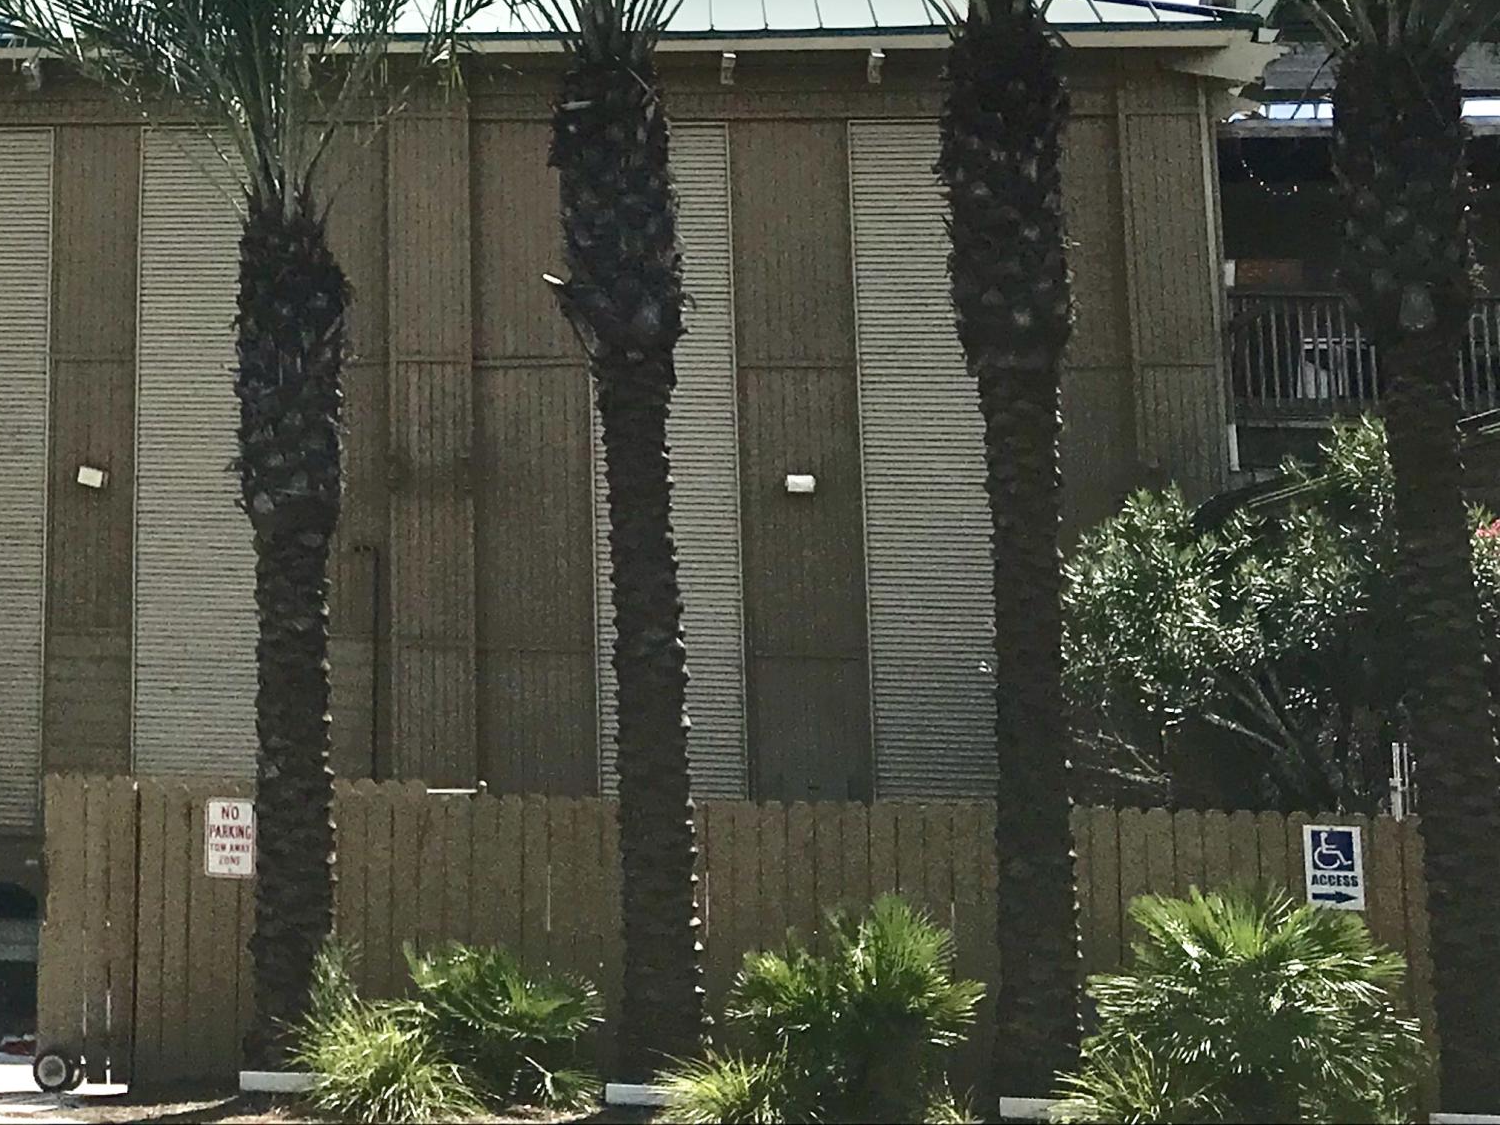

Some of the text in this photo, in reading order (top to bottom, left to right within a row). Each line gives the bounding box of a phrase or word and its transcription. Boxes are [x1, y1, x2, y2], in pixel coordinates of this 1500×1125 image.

[221, 806, 240, 820] NO
[209, 824, 252, 840] PARKING
[1311, 874, 1359, 887] ACCESS
